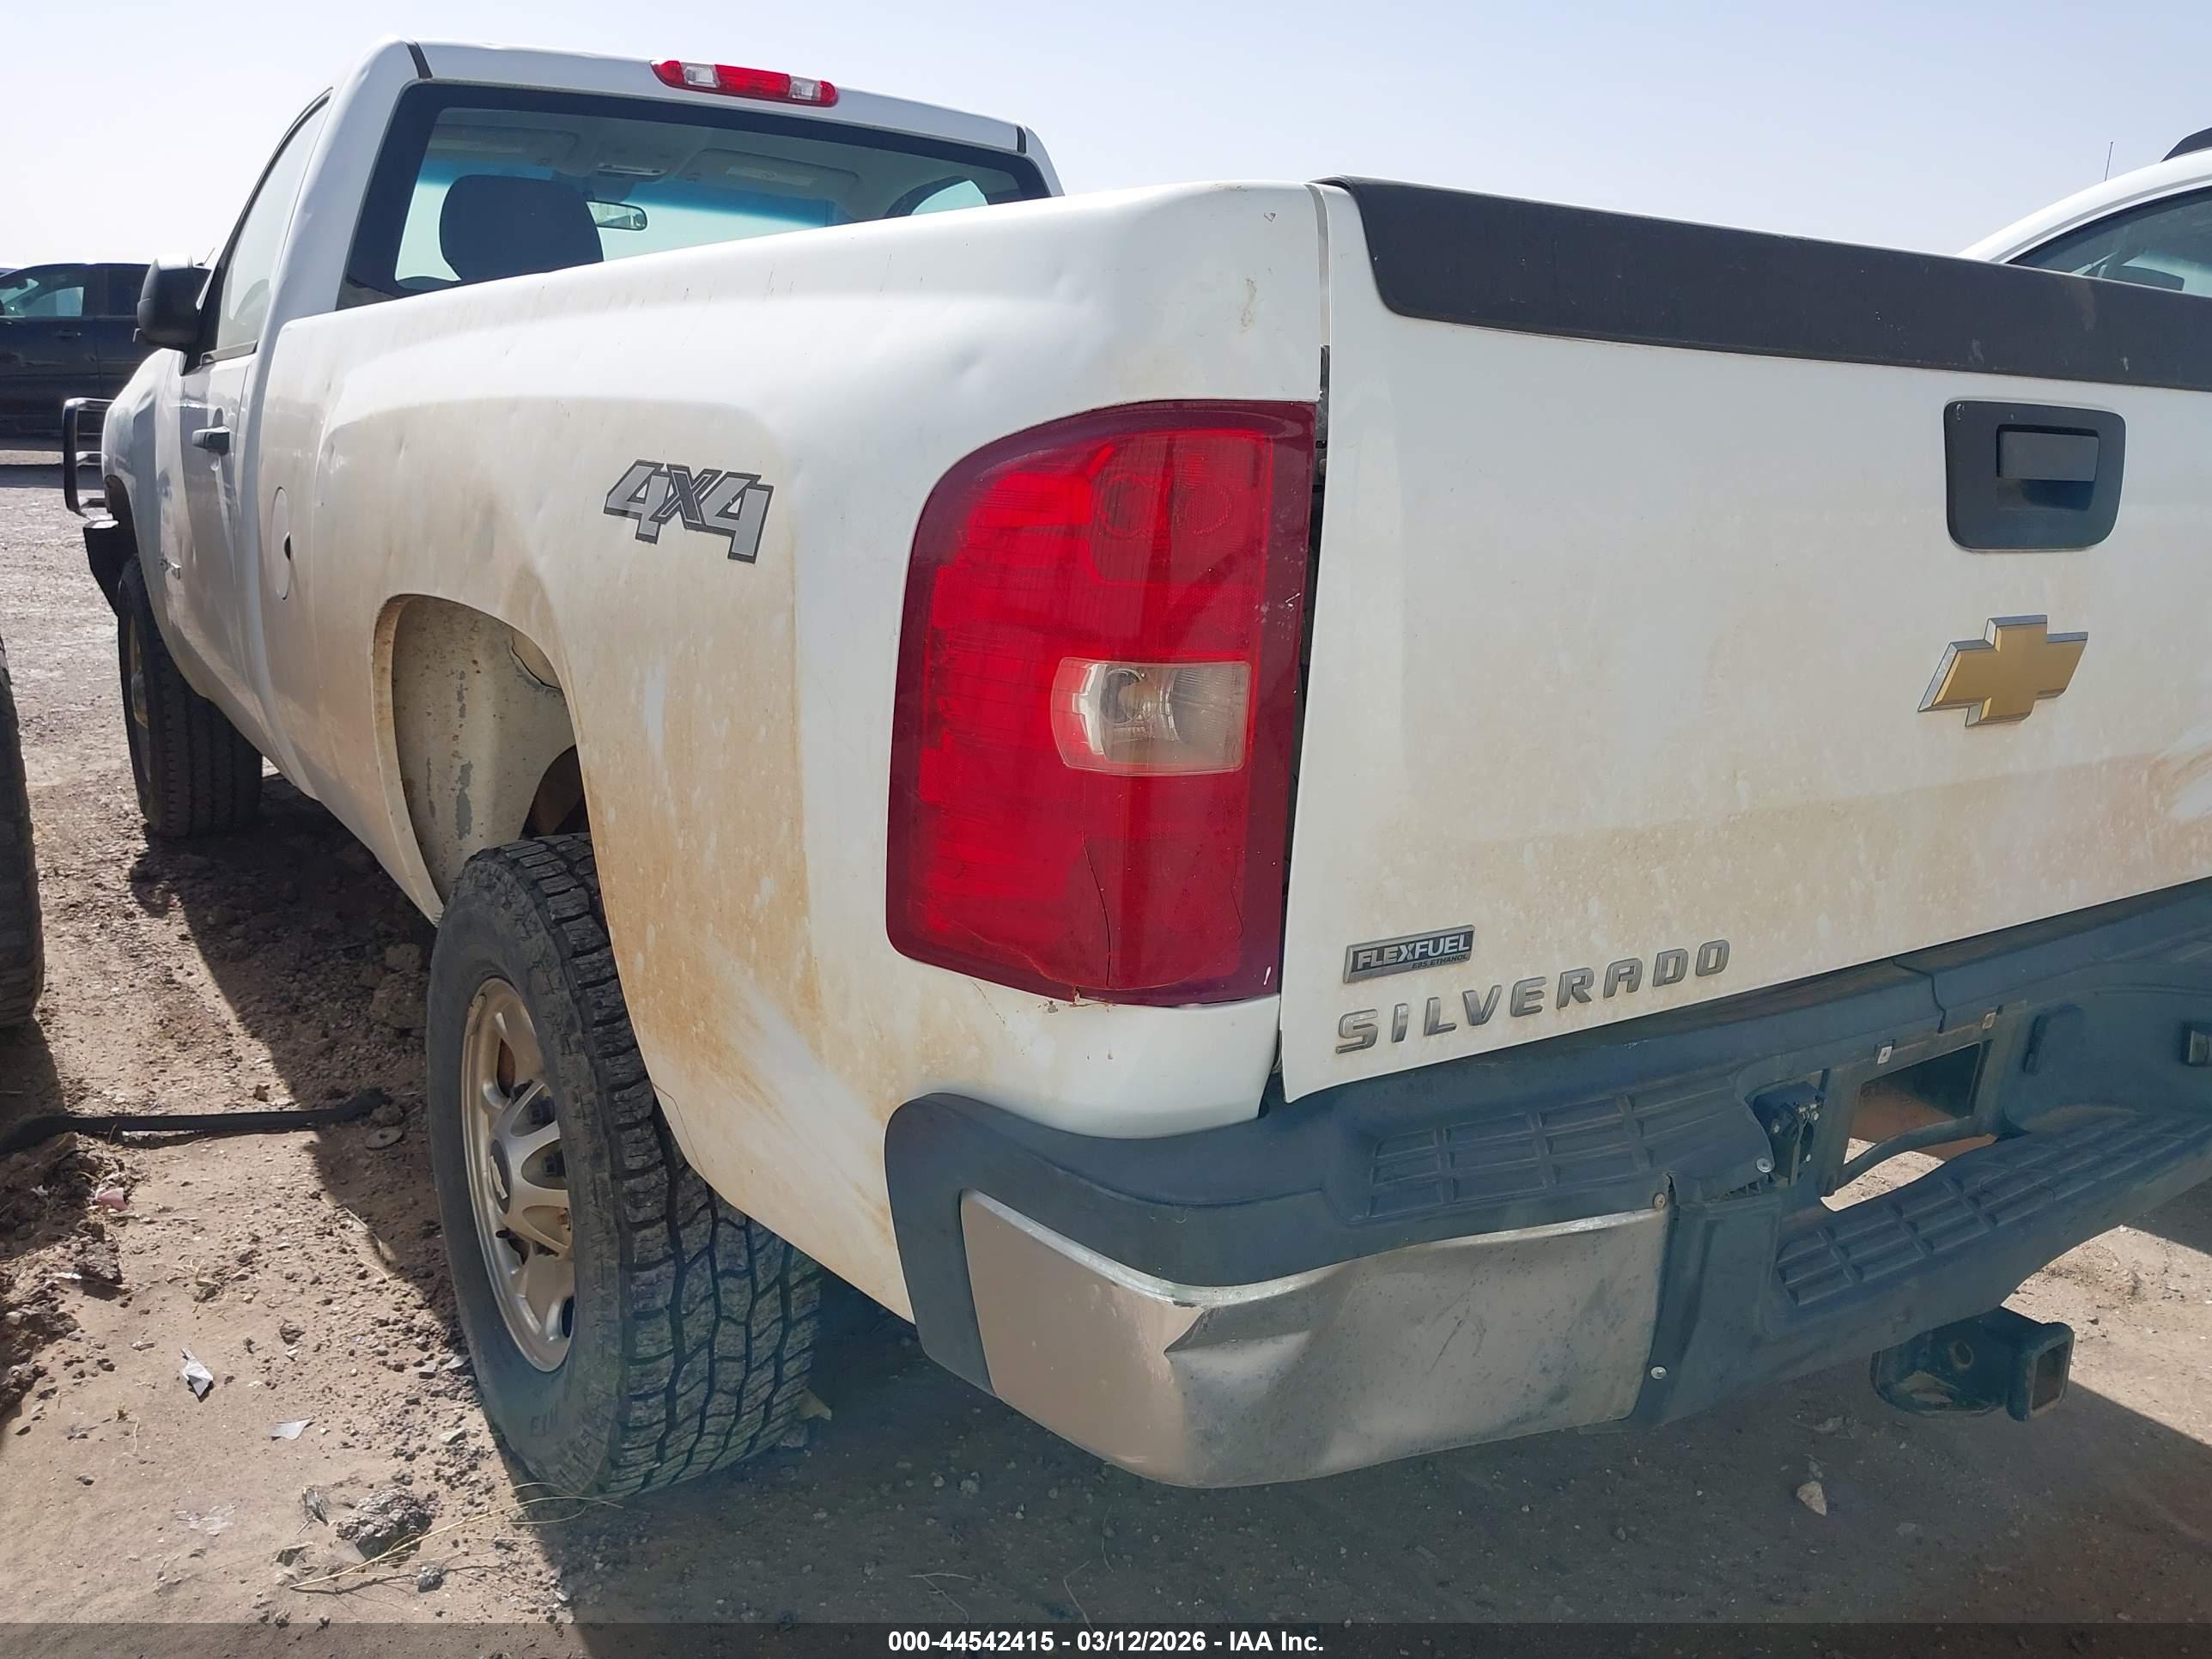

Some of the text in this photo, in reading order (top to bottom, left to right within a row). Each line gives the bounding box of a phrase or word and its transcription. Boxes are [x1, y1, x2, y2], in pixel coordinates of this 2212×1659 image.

[1357, 933, 1470, 969] FLEXFUEL
[1429, 953, 1468, 968] ETHANOL
[1335, 939, 1730, 1054] SILVERADO
